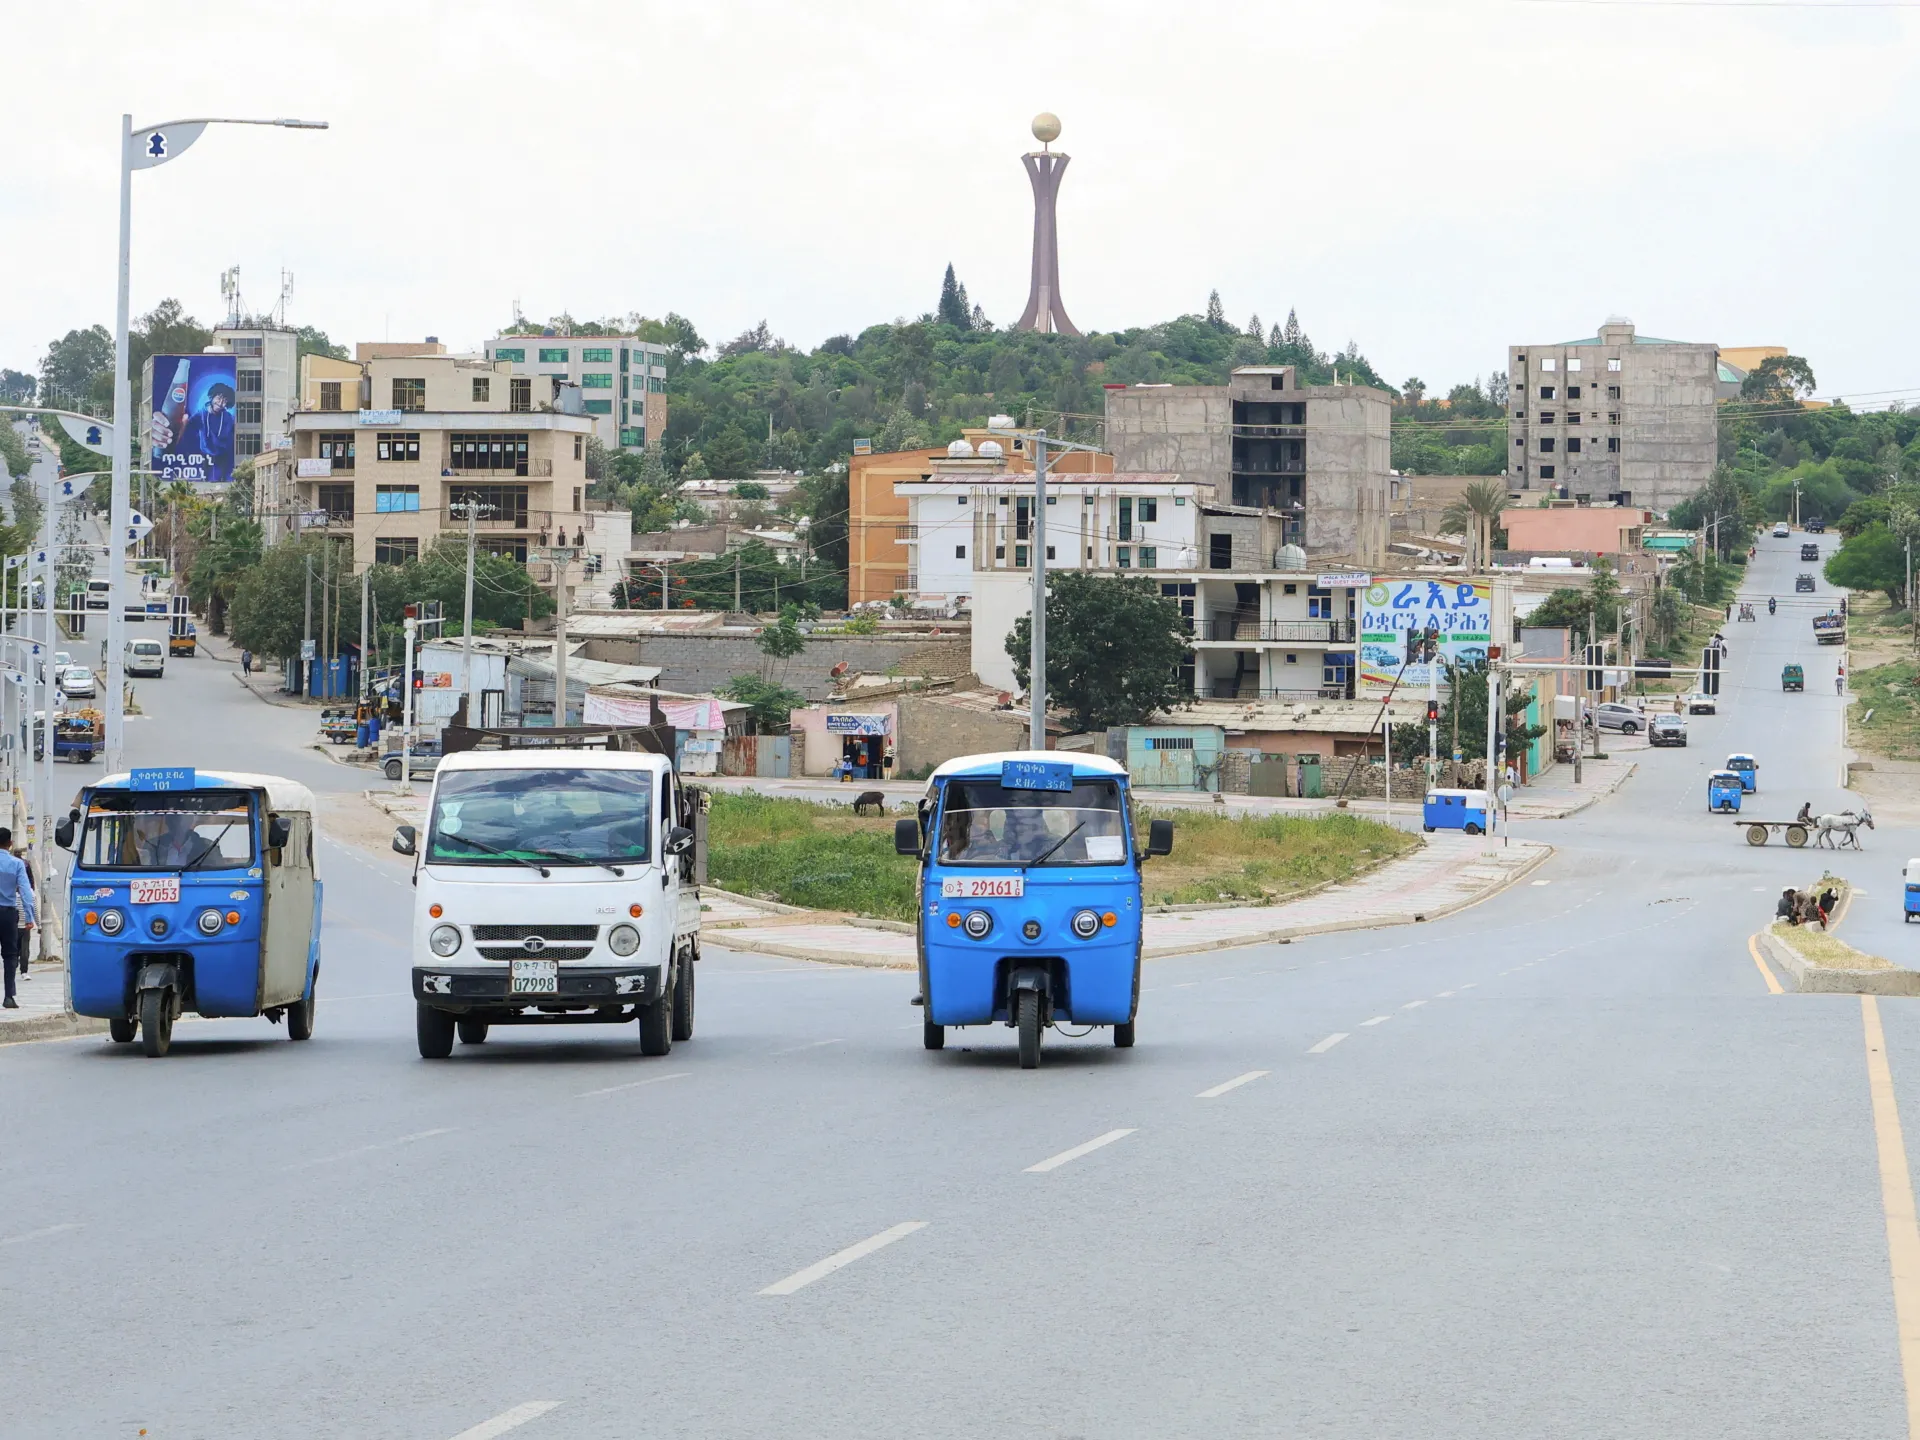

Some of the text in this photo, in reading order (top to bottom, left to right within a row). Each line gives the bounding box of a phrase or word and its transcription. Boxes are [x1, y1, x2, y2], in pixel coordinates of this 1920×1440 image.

[162, 454, 214, 466] ጥዒሙኒ
[153, 781, 170, 790] 101
[1045, 779, 1066, 790] 358
[972, 880, 1012, 896] 29161
[139, 888, 177, 902] 27053
[543, 962, 555, 970] TG
[514, 978, 554, 991] 07998
